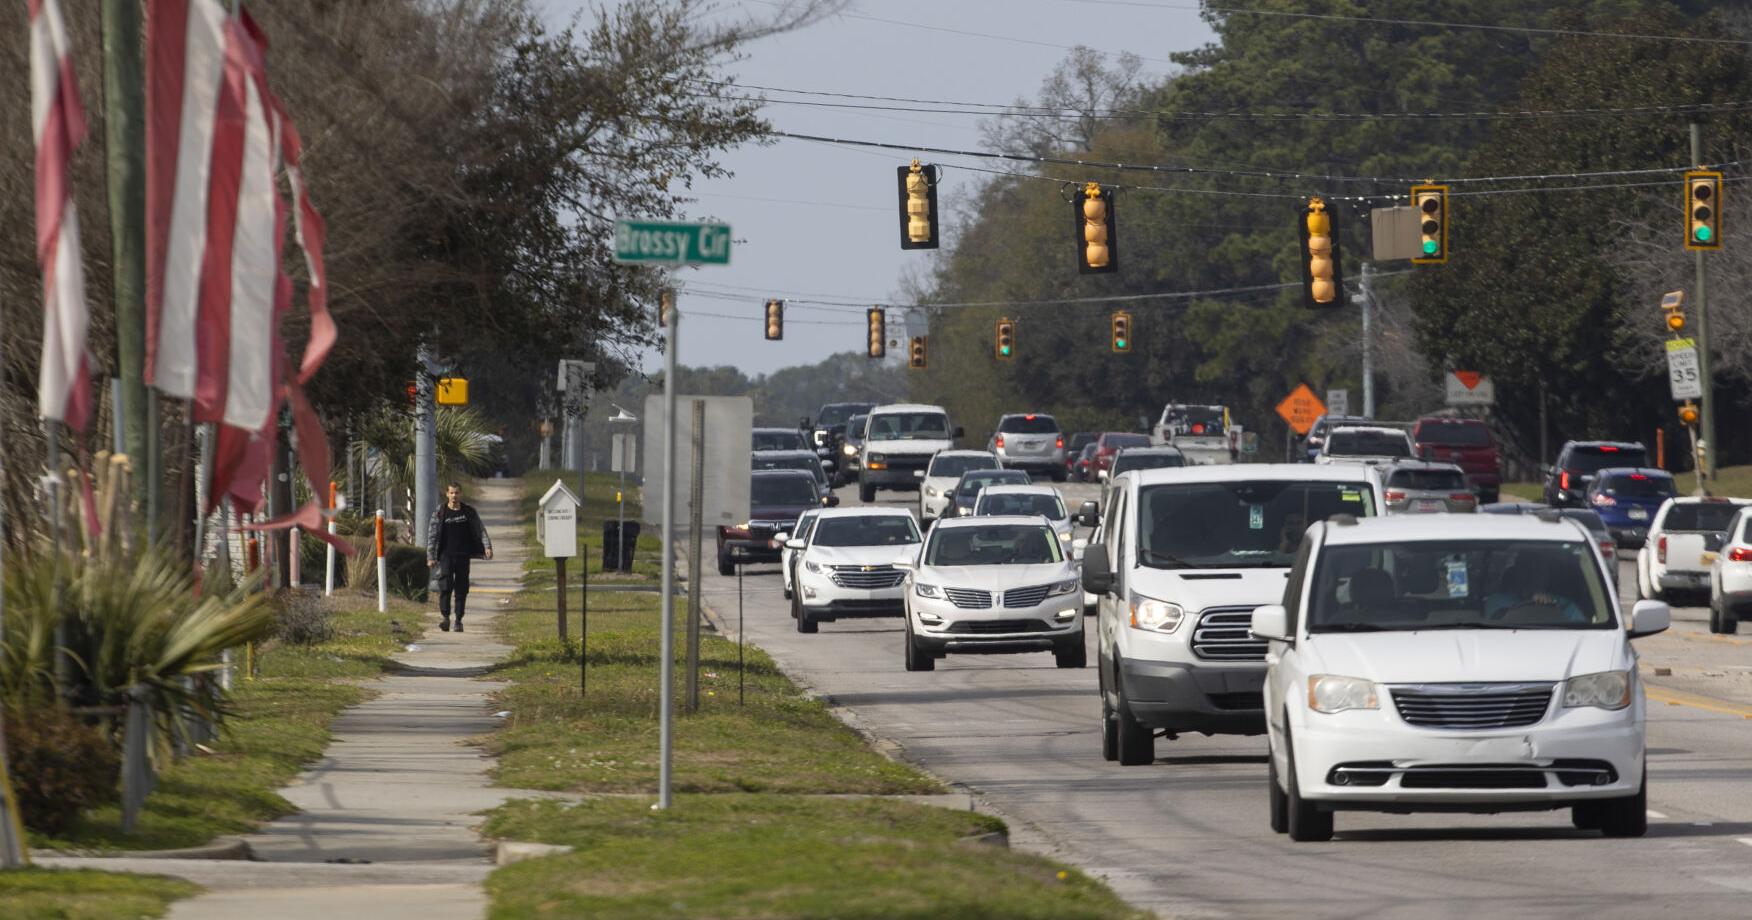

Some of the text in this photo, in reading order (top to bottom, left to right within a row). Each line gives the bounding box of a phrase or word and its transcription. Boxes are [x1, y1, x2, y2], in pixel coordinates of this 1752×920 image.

[617, 223, 727, 262] Brossy Cir
[1673, 367, 1697, 383] 35
